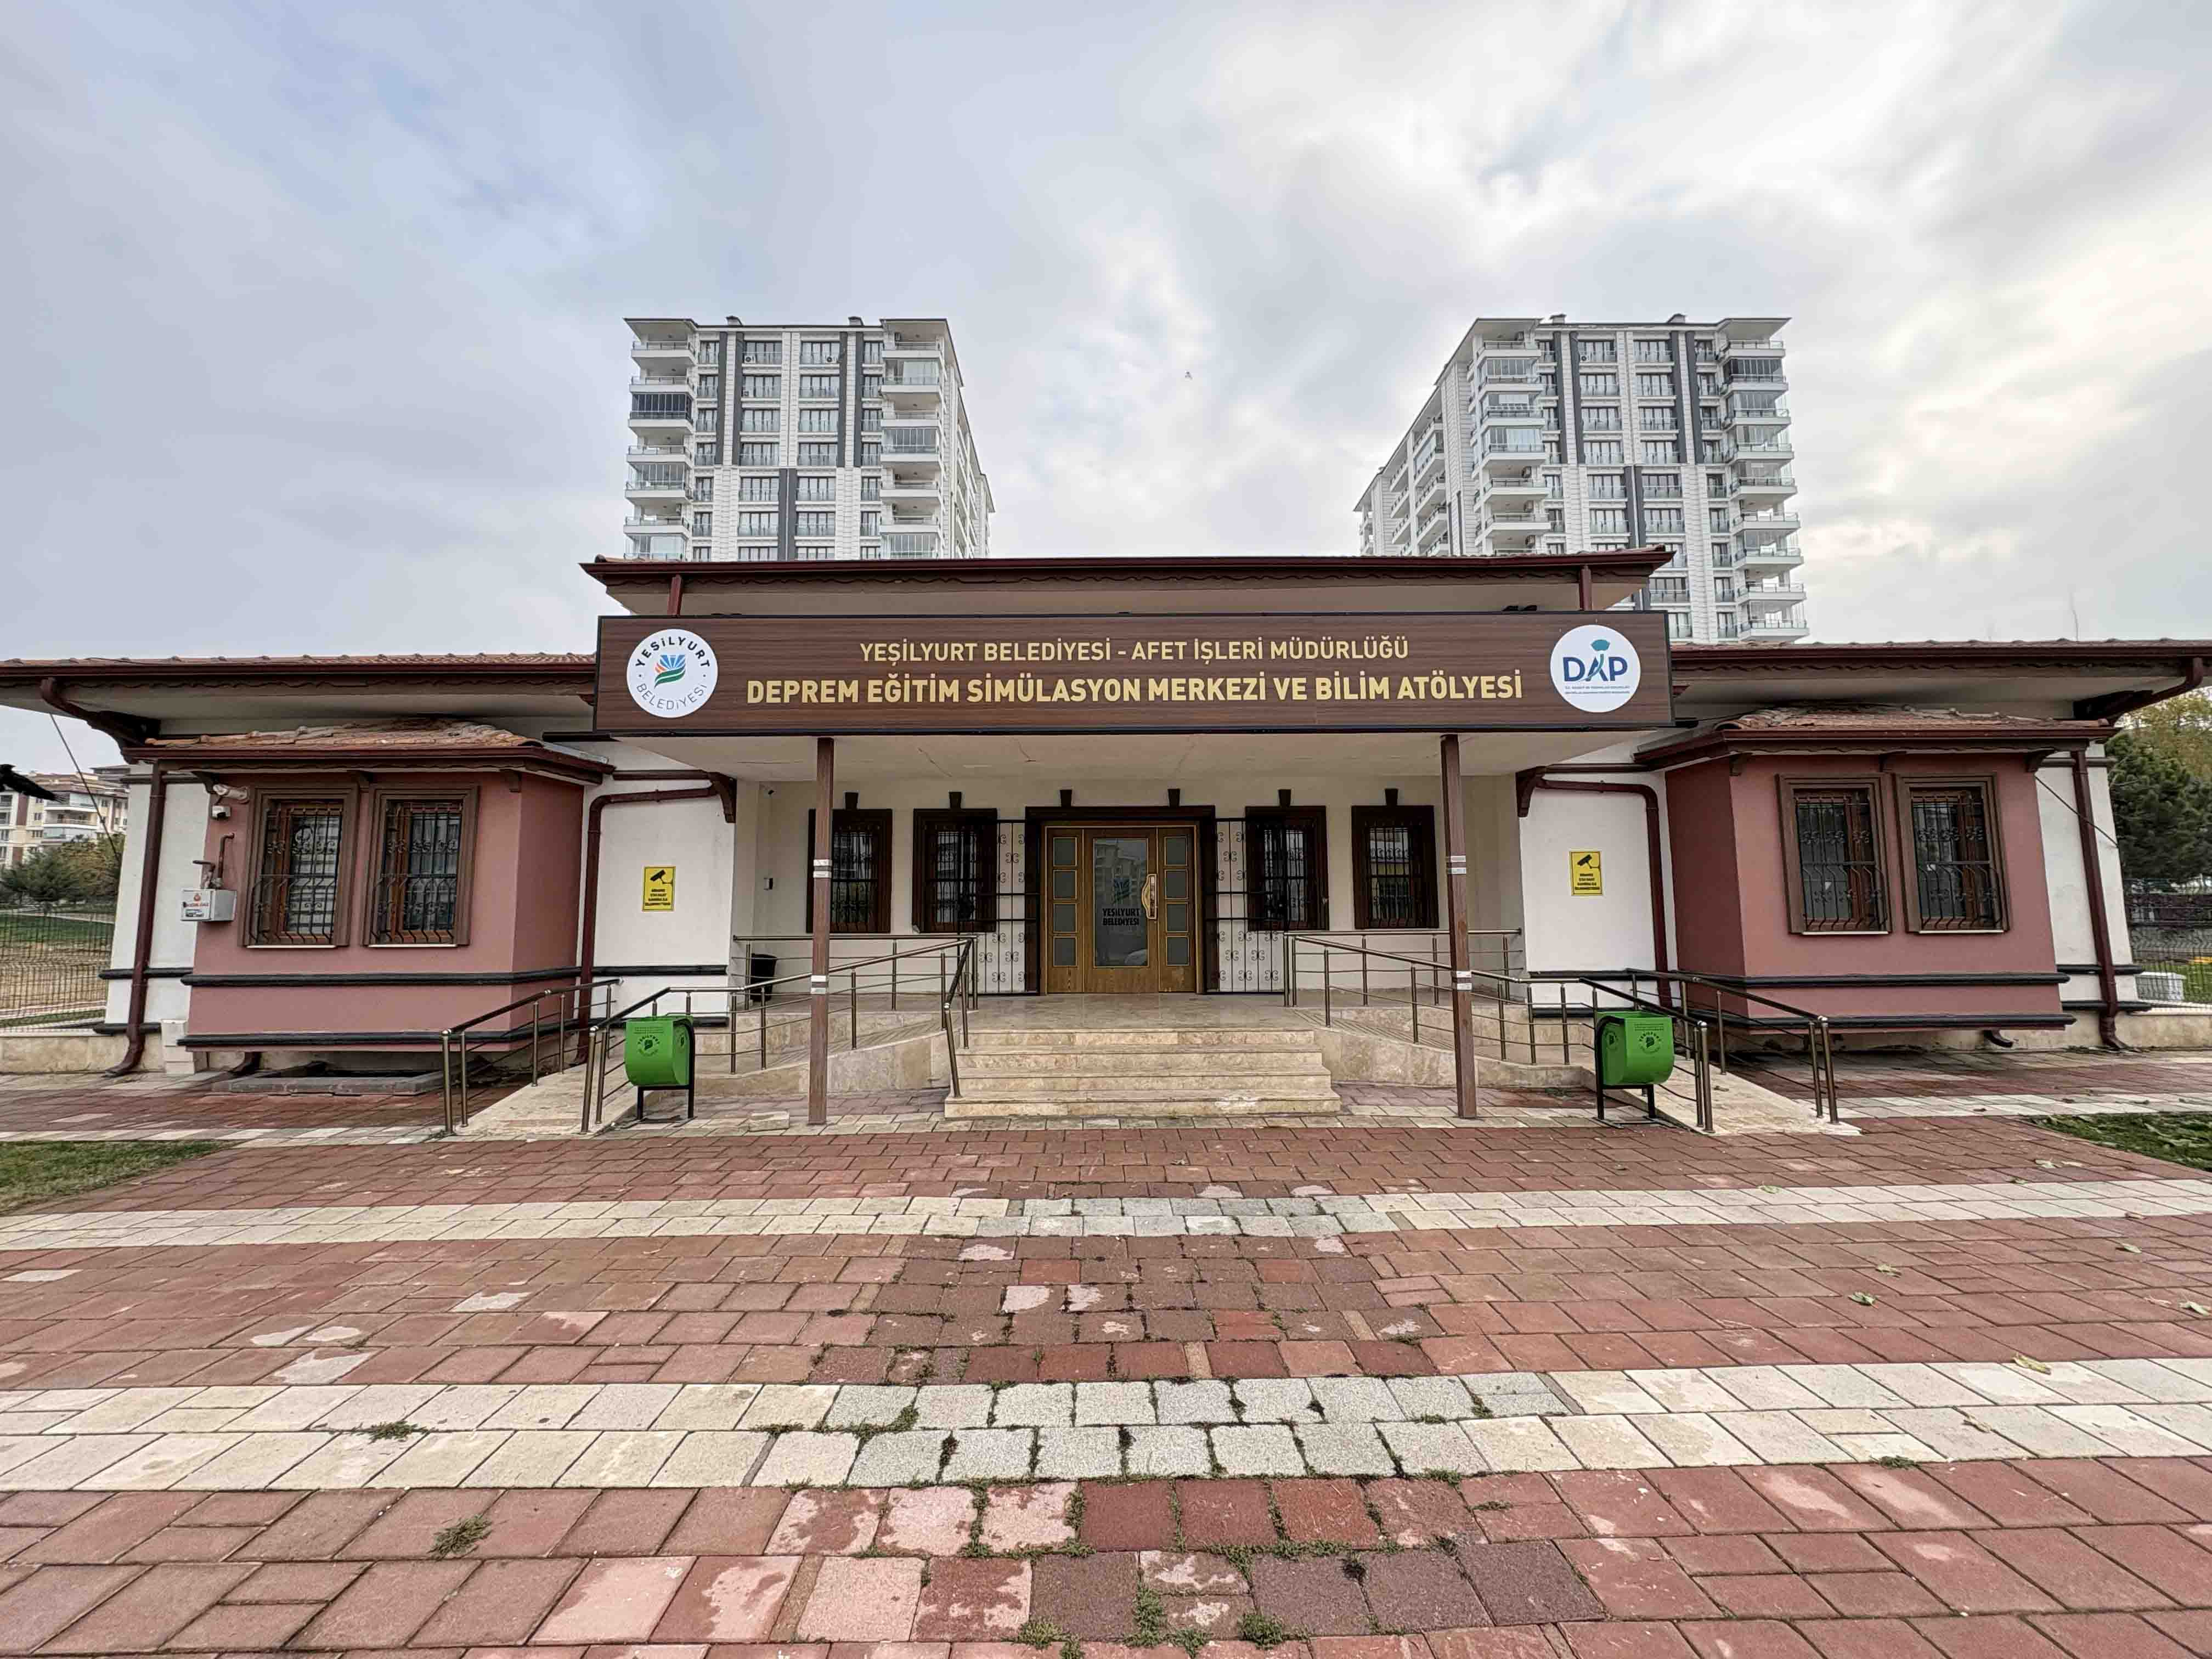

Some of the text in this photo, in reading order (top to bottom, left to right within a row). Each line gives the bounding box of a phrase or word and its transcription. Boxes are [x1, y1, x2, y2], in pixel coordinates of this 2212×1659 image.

[860, 637, 978, 666] YEŞİLYURT
[984, 636, 1110, 661] BELEDİYESİ
[1131, 641, 1186, 659] AFET
[1194, 635, 1263, 665] İŞLERİ
[1271, 635, 1408, 659] MÜDÜRLÜĞÜ
[1562, 654, 1628, 681] DAP
[747, 669, 1522, 704] DEPREM EĞİTİM SİMÜLASYON MERKEZİ VE BİLİM ATÖLYESİ
